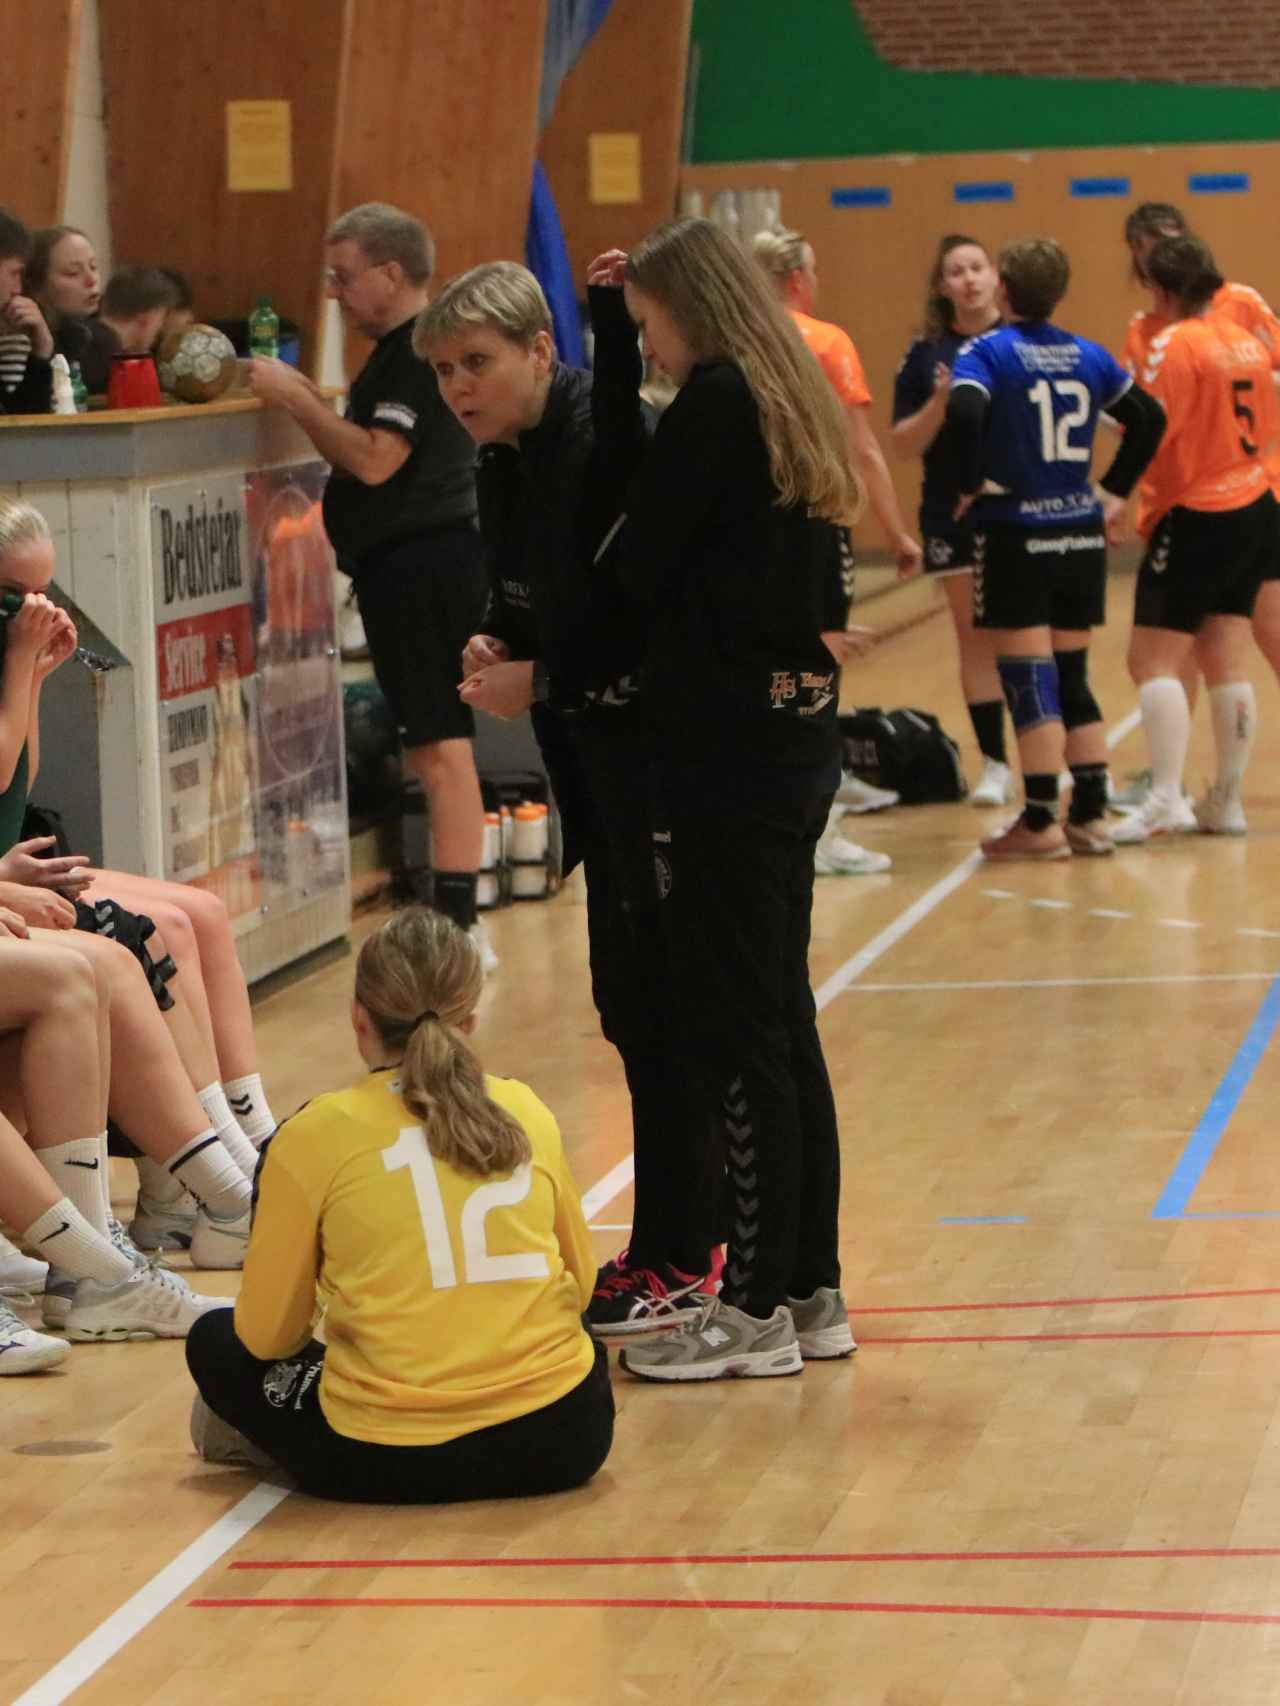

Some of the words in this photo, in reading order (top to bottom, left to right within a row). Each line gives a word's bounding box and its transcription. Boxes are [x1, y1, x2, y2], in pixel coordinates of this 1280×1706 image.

[1029, 379, 1091, 463] 12
[1232, 378, 1259, 457] 5
[1020, 497, 1064, 514] AUTO
[380, 1125, 550, 1290] 12
